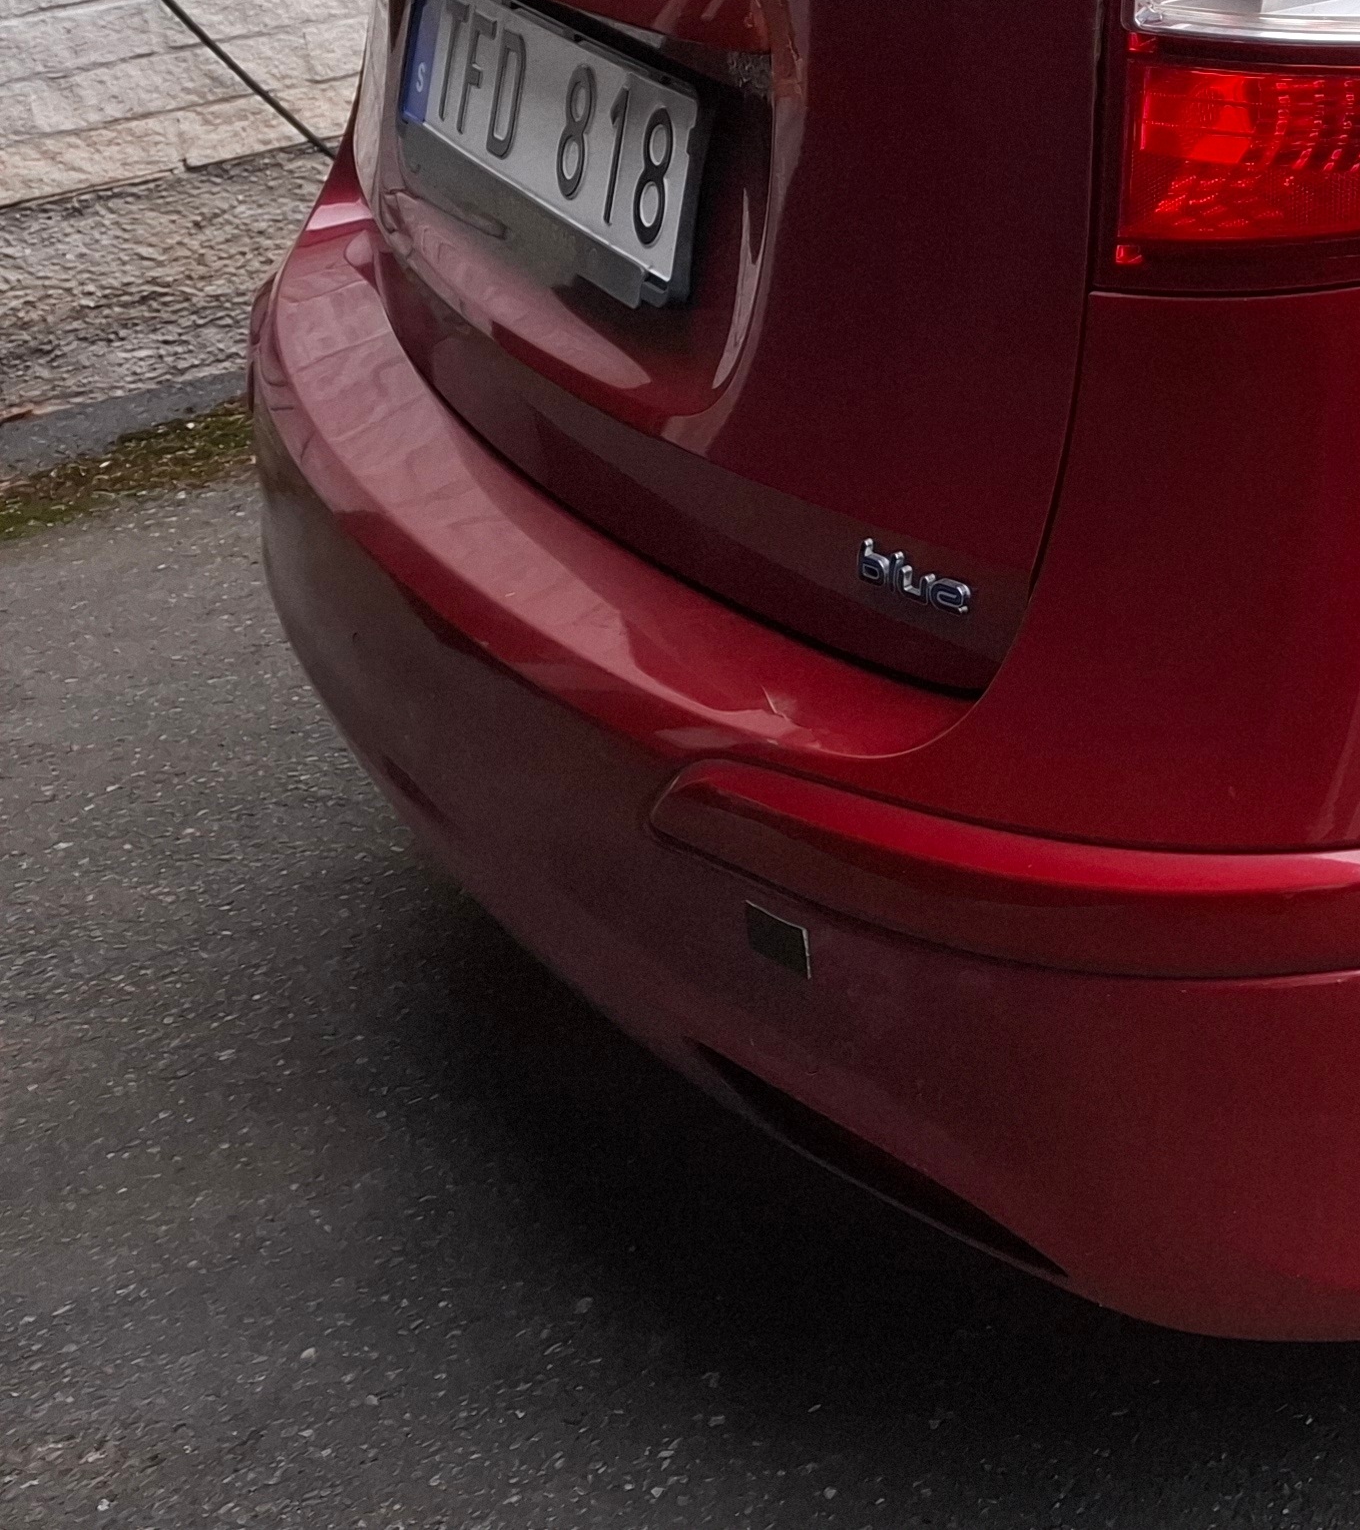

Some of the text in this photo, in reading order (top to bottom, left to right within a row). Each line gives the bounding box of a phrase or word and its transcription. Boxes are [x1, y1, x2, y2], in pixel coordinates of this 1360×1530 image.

[415, 62, 427, 93] S
[556, 64, 675, 246] 818
[857, 537, 972, 616] blue
